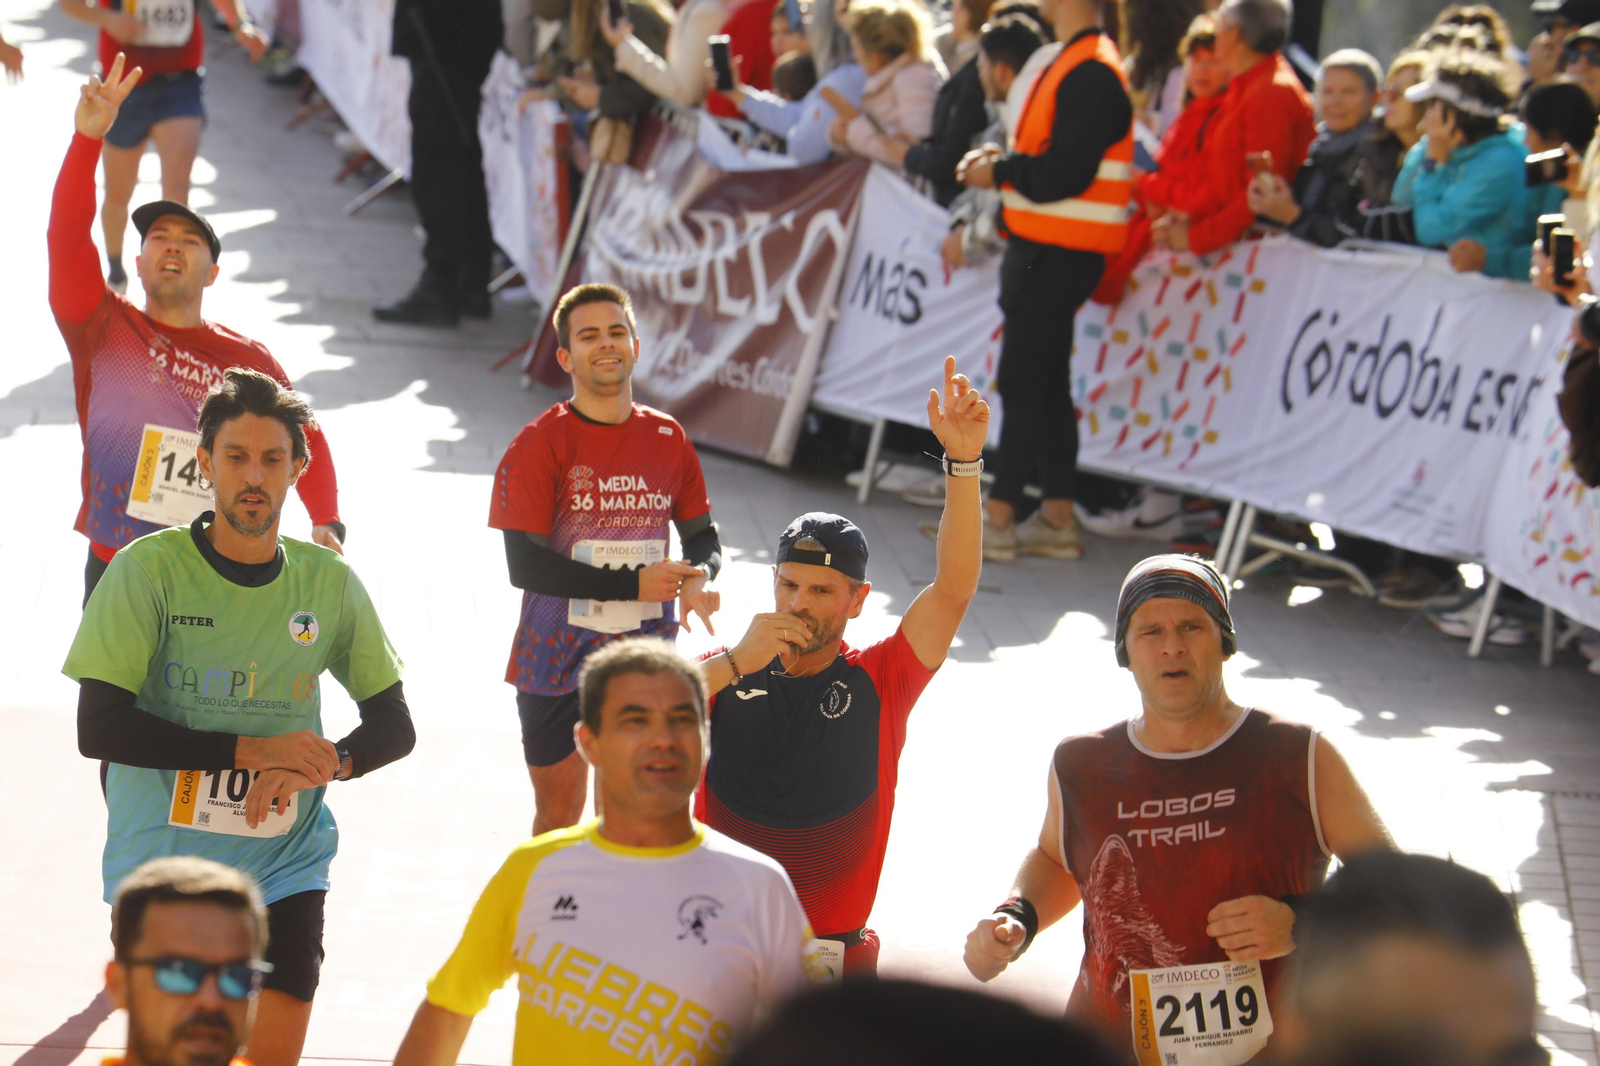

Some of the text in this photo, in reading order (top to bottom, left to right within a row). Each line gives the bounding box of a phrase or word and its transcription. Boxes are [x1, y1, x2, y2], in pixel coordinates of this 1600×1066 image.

[598, 475, 648, 492] MEDIA
[571, 489, 672, 511] 36 MARATÓN
[606, 546, 643, 555] IMDECO
[171, 614, 214, 628] PETER
[164, 659, 318, 702] CAMPILLOS
[194, 695, 291, 710] TODO LO QUE NECESITAS
[207, 799, 241, 809] FRANCISCO
[1117, 788, 1236, 820] LOBOS
[1127, 820, 1226, 848] TRAIL
[1167, 968, 1220, 983] IMDECO
[519, 931, 733, 1055] LIEBRES
[1155, 985, 1259, 1037] 2119
[1138, 1009, 1150, 1049] CAJÓN
[1173, 1027, 1253, 1044] JUAN ENRIQUE NAVARRO
[1194, 1039, 1233, 1049] FERNANDEZ
